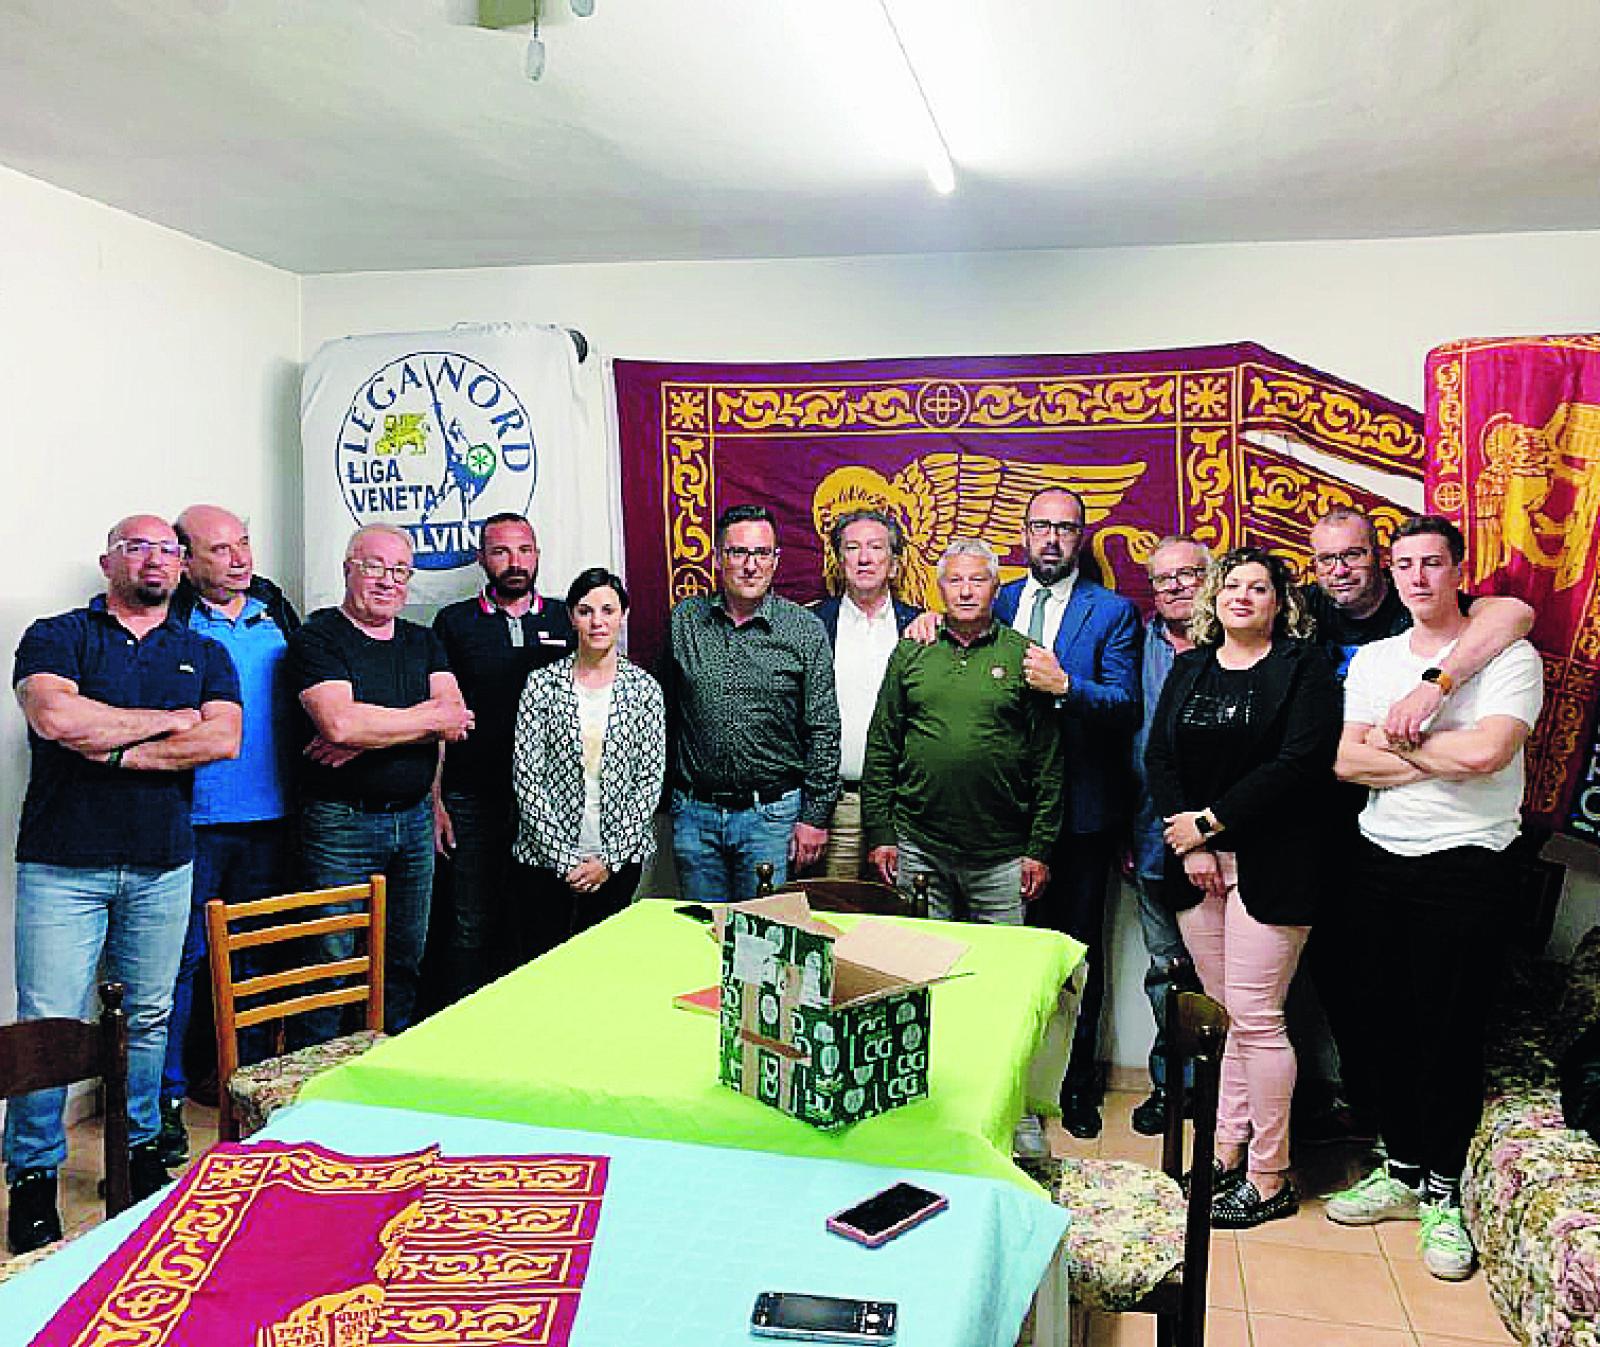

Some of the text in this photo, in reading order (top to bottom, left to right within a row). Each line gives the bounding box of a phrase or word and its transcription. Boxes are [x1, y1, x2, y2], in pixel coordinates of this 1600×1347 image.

[343, 356, 531, 472] LEGA NORD
[347, 459, 403, 484] LIGA
[350, 484, 439, 512] VENETA
